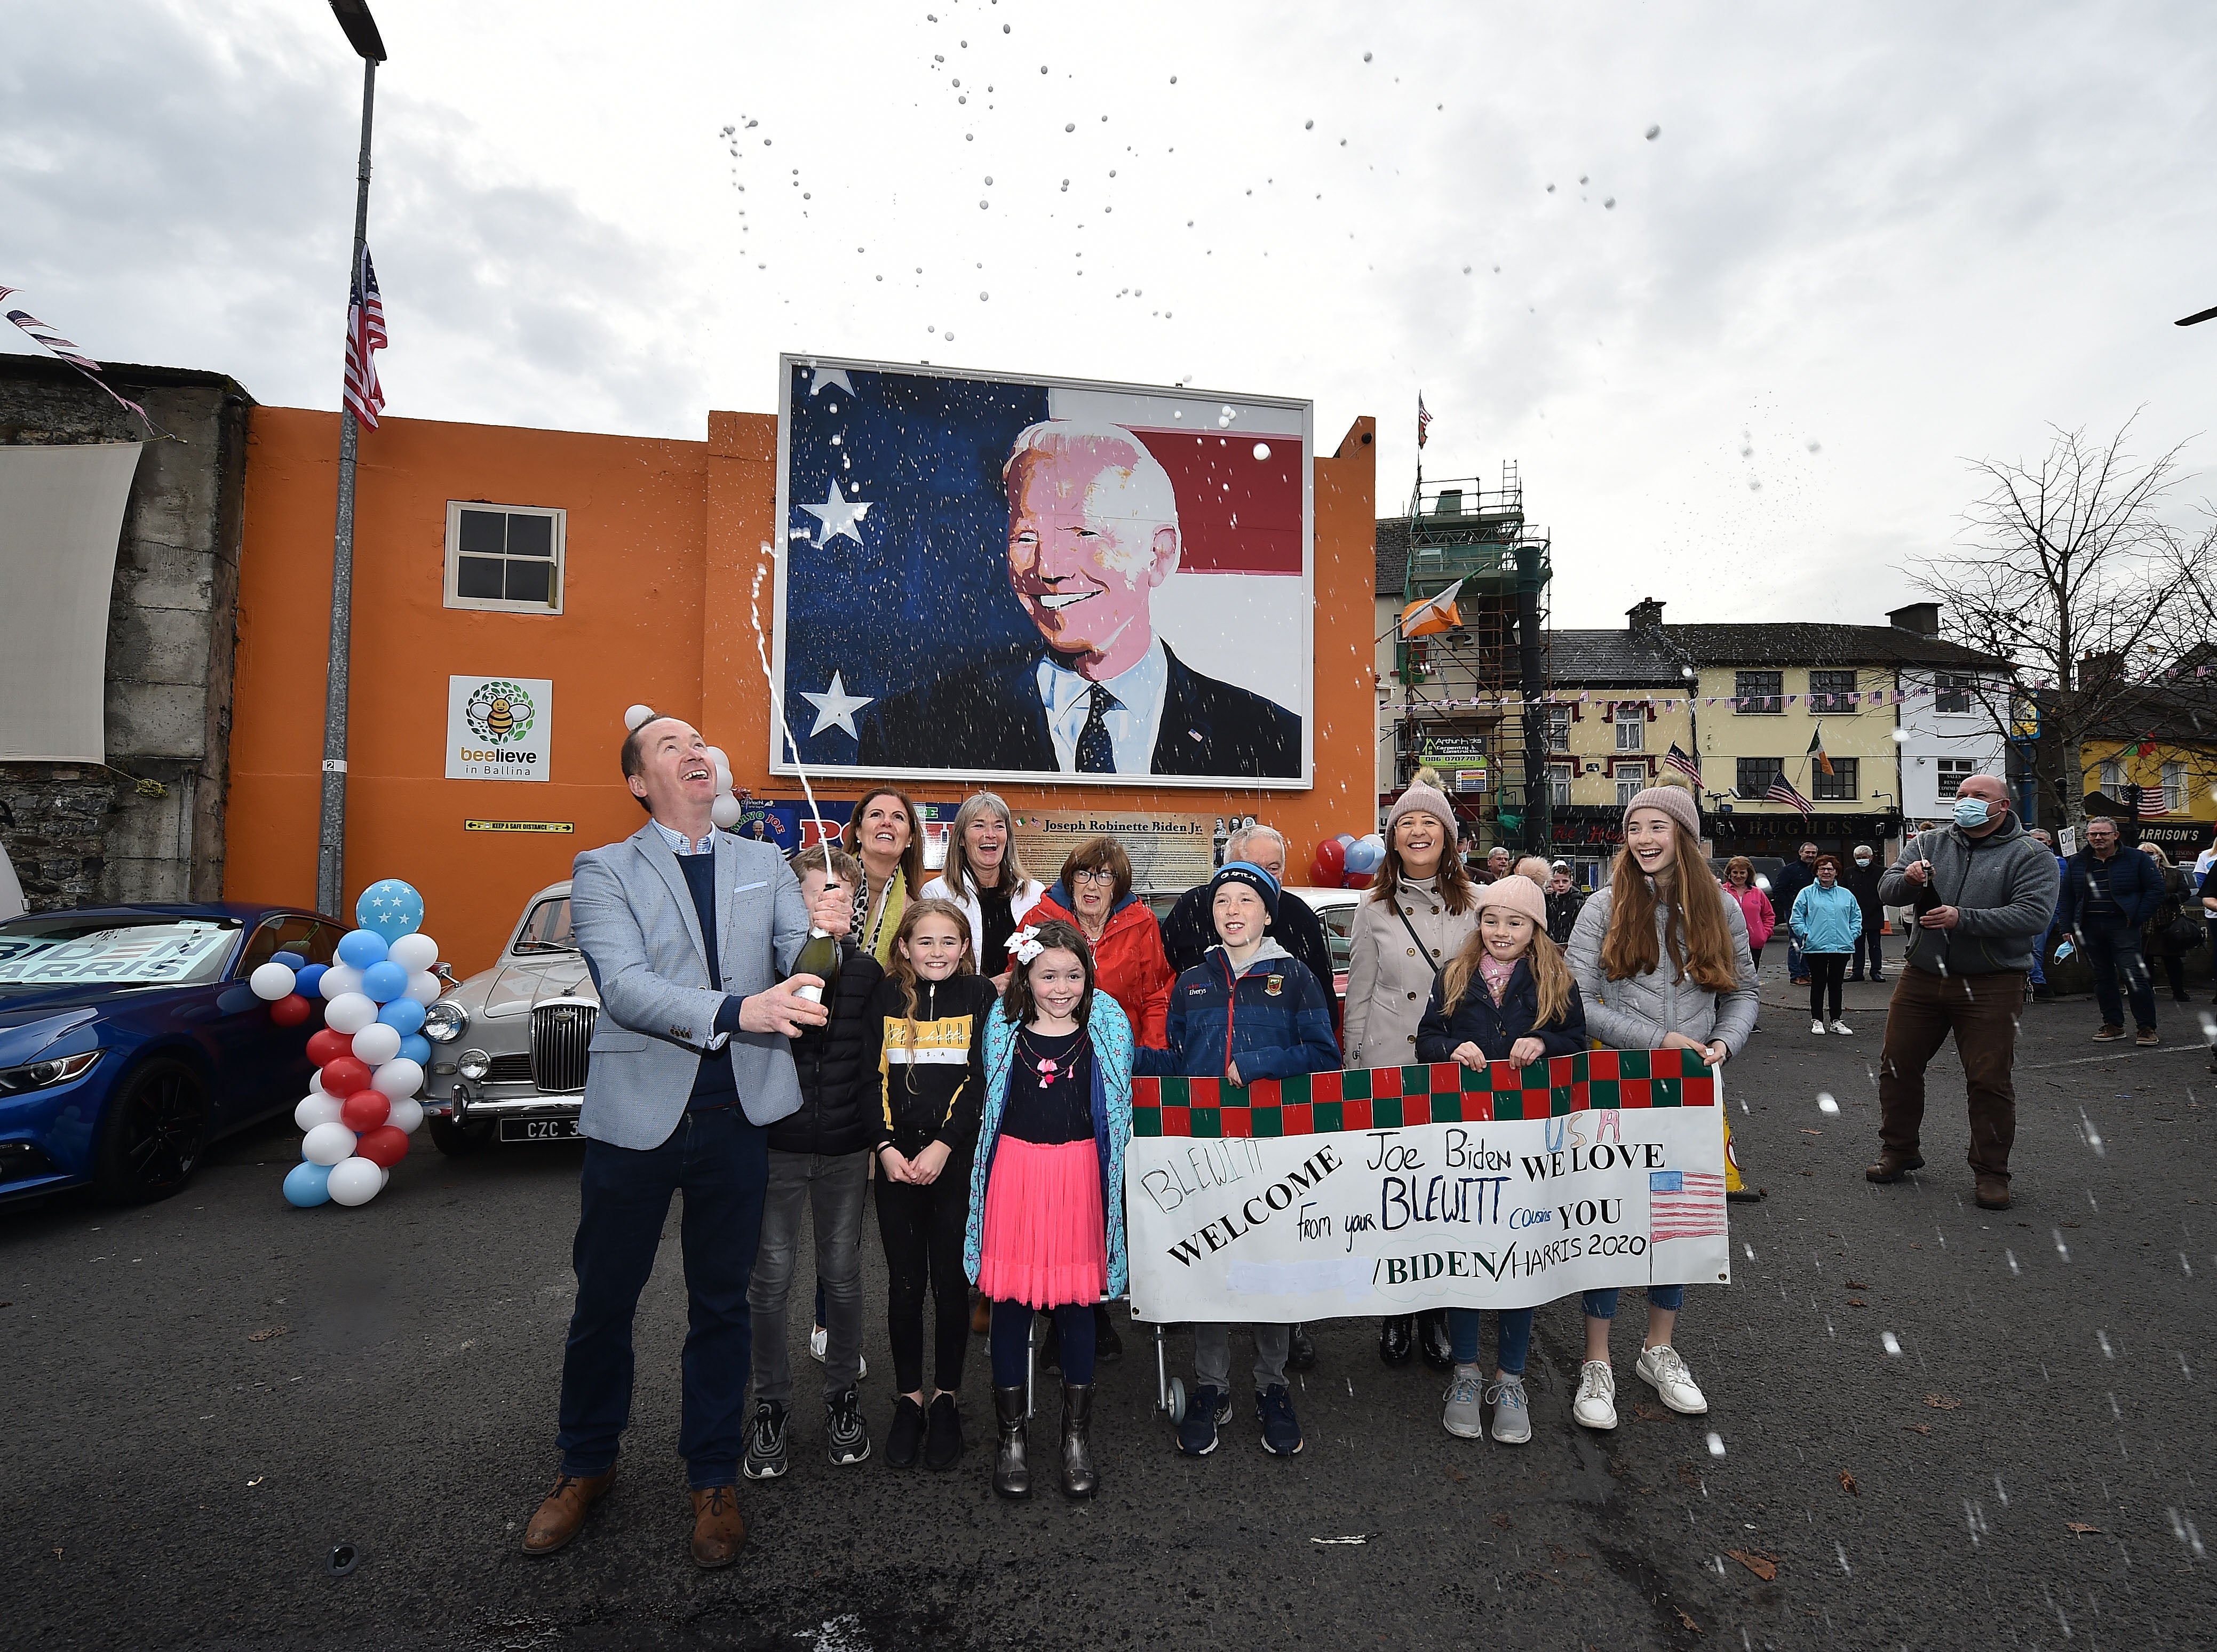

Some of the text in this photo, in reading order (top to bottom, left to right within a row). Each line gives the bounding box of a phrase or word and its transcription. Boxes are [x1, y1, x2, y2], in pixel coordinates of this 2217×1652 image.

[327, 761, 333, 770] 2
[460, 747, 537, 764] beelieve
[466, 765, 531, 776] in Ballina
[730, 811, 785, 834] MAYO JOE
[1043, 819, 1203, 834] Joseph Robinette Biden Jr.
[1749, 821, 1853, 835] HUGHES
[2138, 828, 2199, 841] ARRISON'S
[0, 936, 218, 961] BIDEN
[0, 960, 188, 979] ARRIS
[528, 1121, 579, 1138] CZC 3
[1545, 1110, 1621, 1152] USA
[1366, 1131, 1426, 1172] Joe
[1520, 1143, 1665, 1183] WE LOVE
[1140, 1137, 1274, 1215] BLEWITT
[1166, 1144, 1343, 1268] WELCOME
[1382, 1176, 1512, 1231] BLEWITT
[1556, 1198, 1623, 1231] YOU
[1588, 1233, 1647, 1256] 2020
